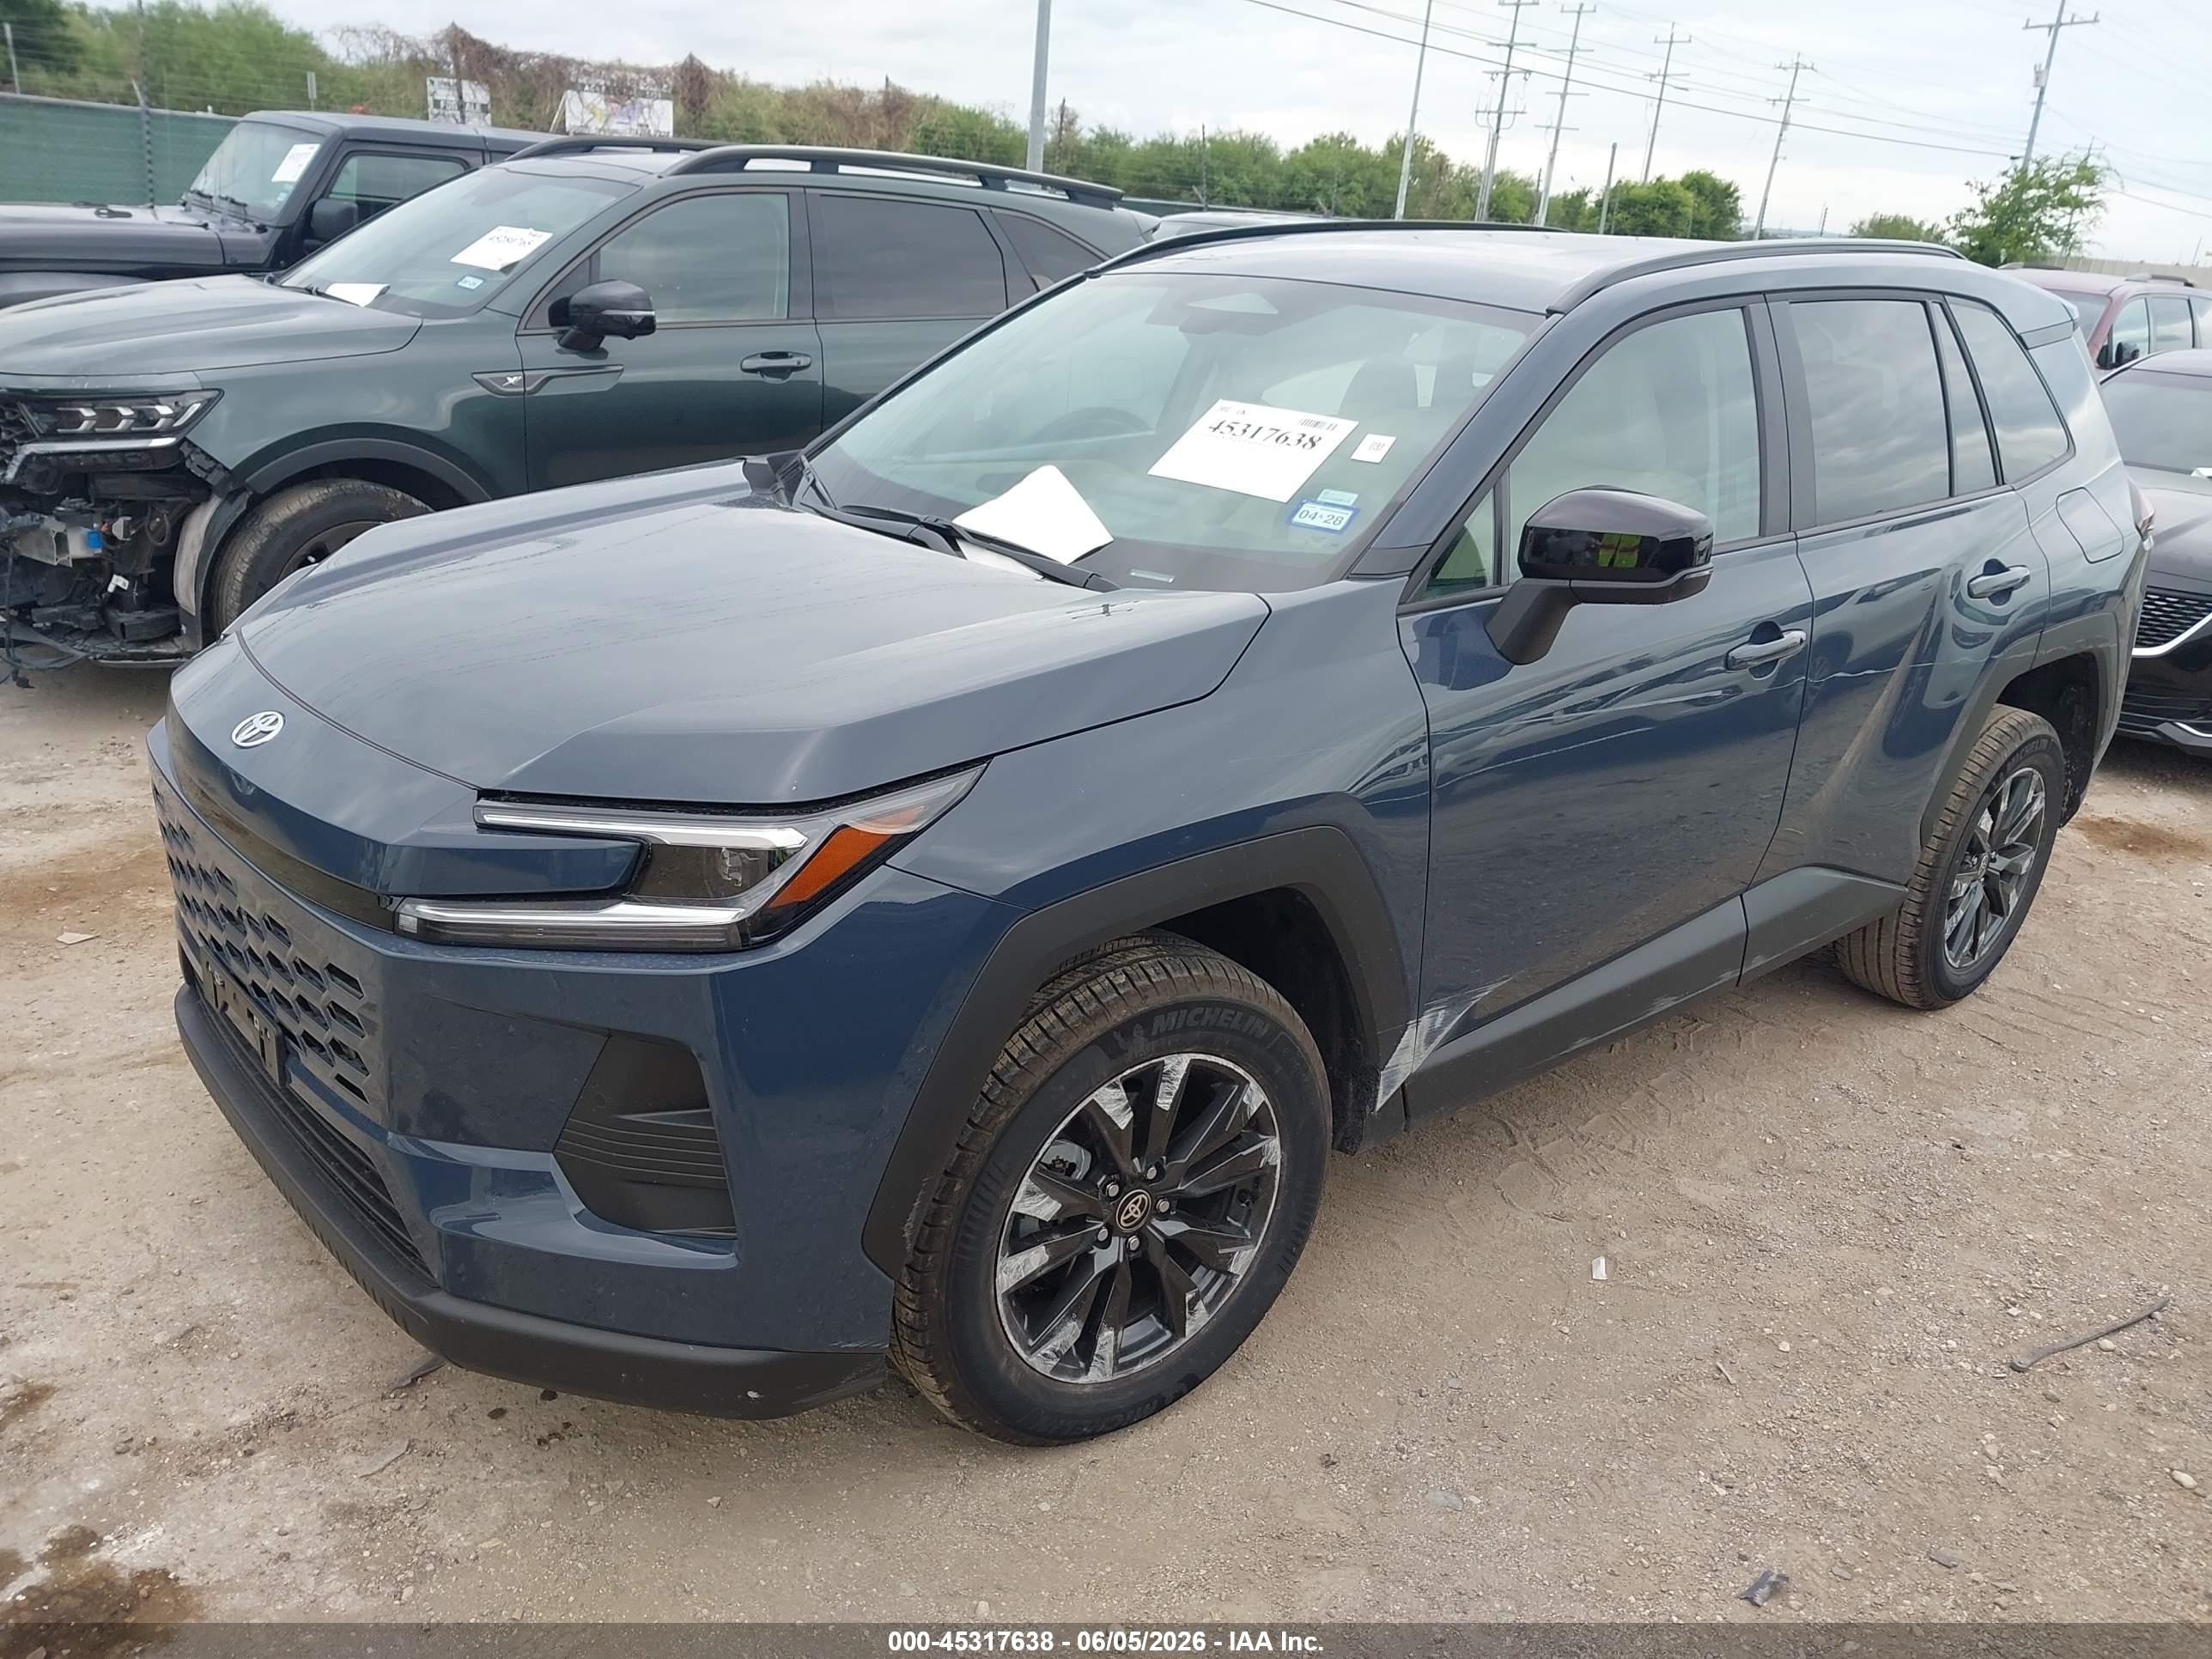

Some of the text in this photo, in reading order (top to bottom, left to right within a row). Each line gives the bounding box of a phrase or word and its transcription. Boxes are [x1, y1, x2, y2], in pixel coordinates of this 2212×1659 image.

[1208, 420, 1322, 451] 45317638
[1298, 509, 1345, 526] 04 28
[1151, 1006, 1272, 1039] MICHELIN
